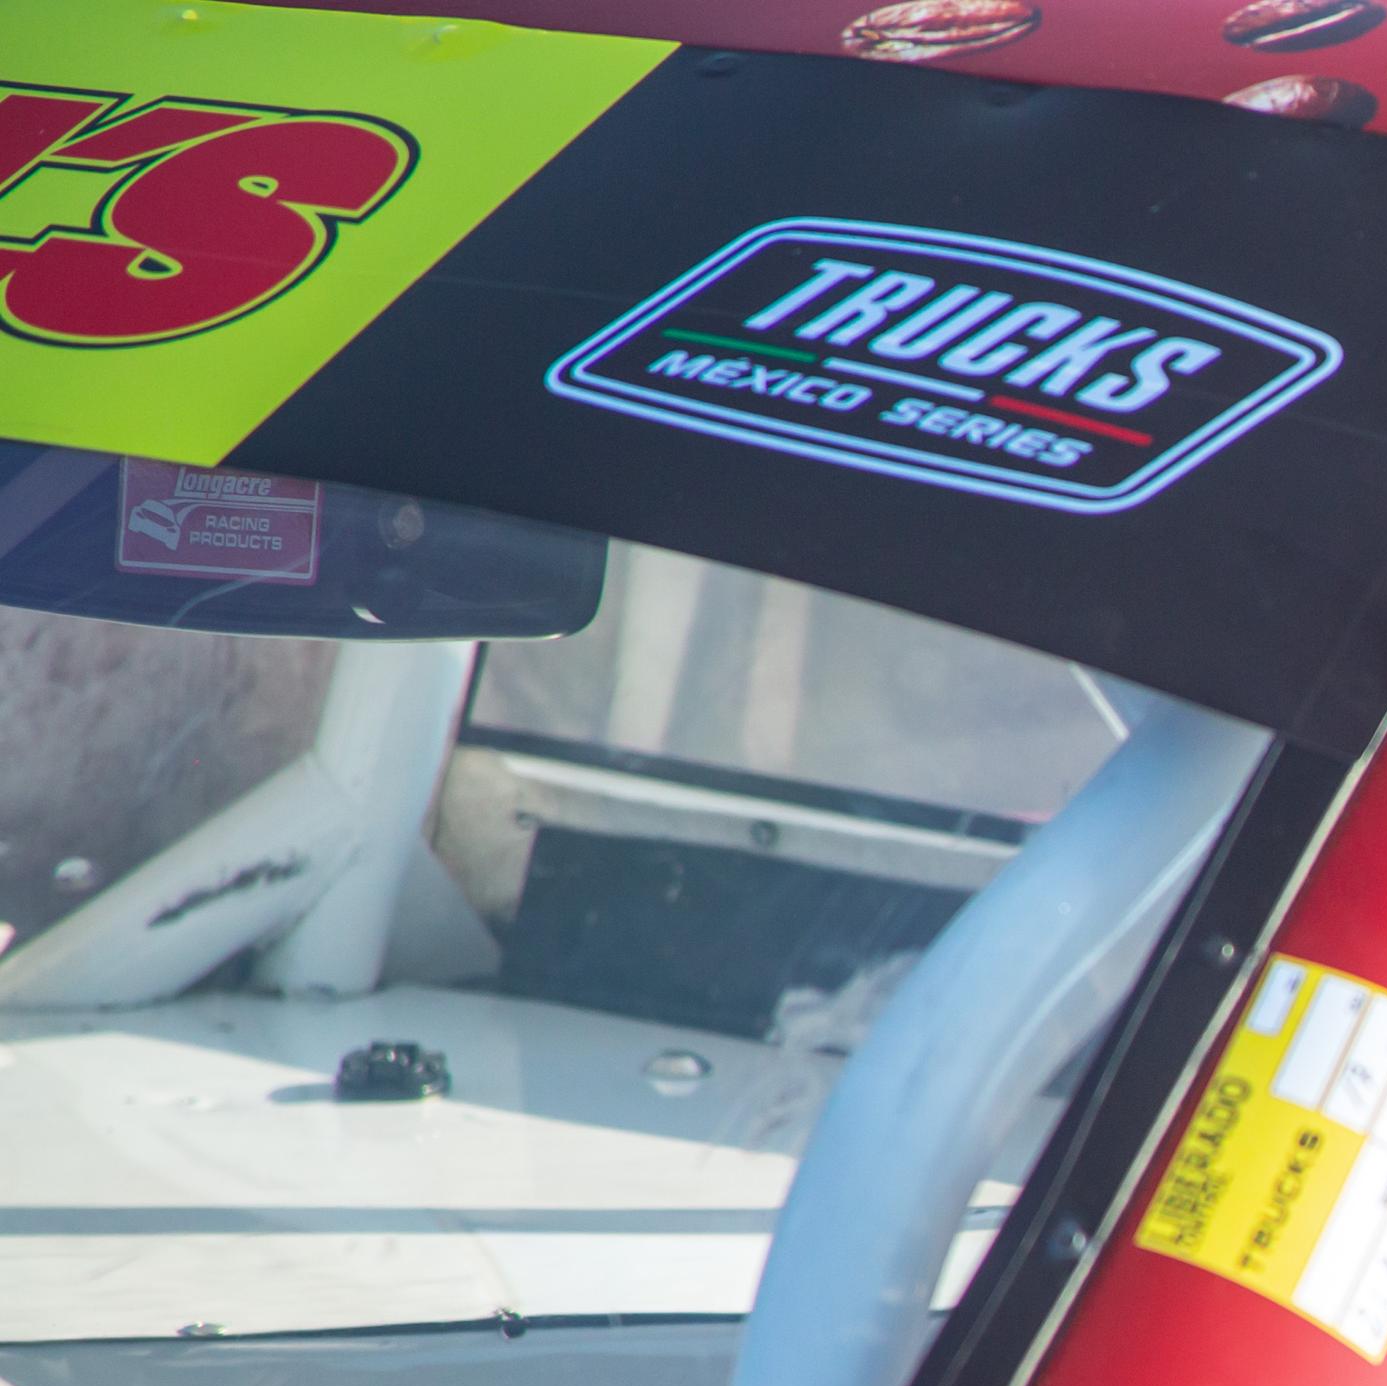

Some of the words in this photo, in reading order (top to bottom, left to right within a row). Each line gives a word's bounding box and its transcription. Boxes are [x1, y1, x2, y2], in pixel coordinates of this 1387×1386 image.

[743, 258, 1221, 413] TRUCKS
[646, 349, 871, 413] MÉXICO
[880, 398, 1093, 467] SERIES
[174, 466, 272, 497] Longacre
[189, 531, 283, 550] PRODUCTS
[205, 515, 270, 532] RACING
[1239, 1129, 1321, 1275] TRUCKS
